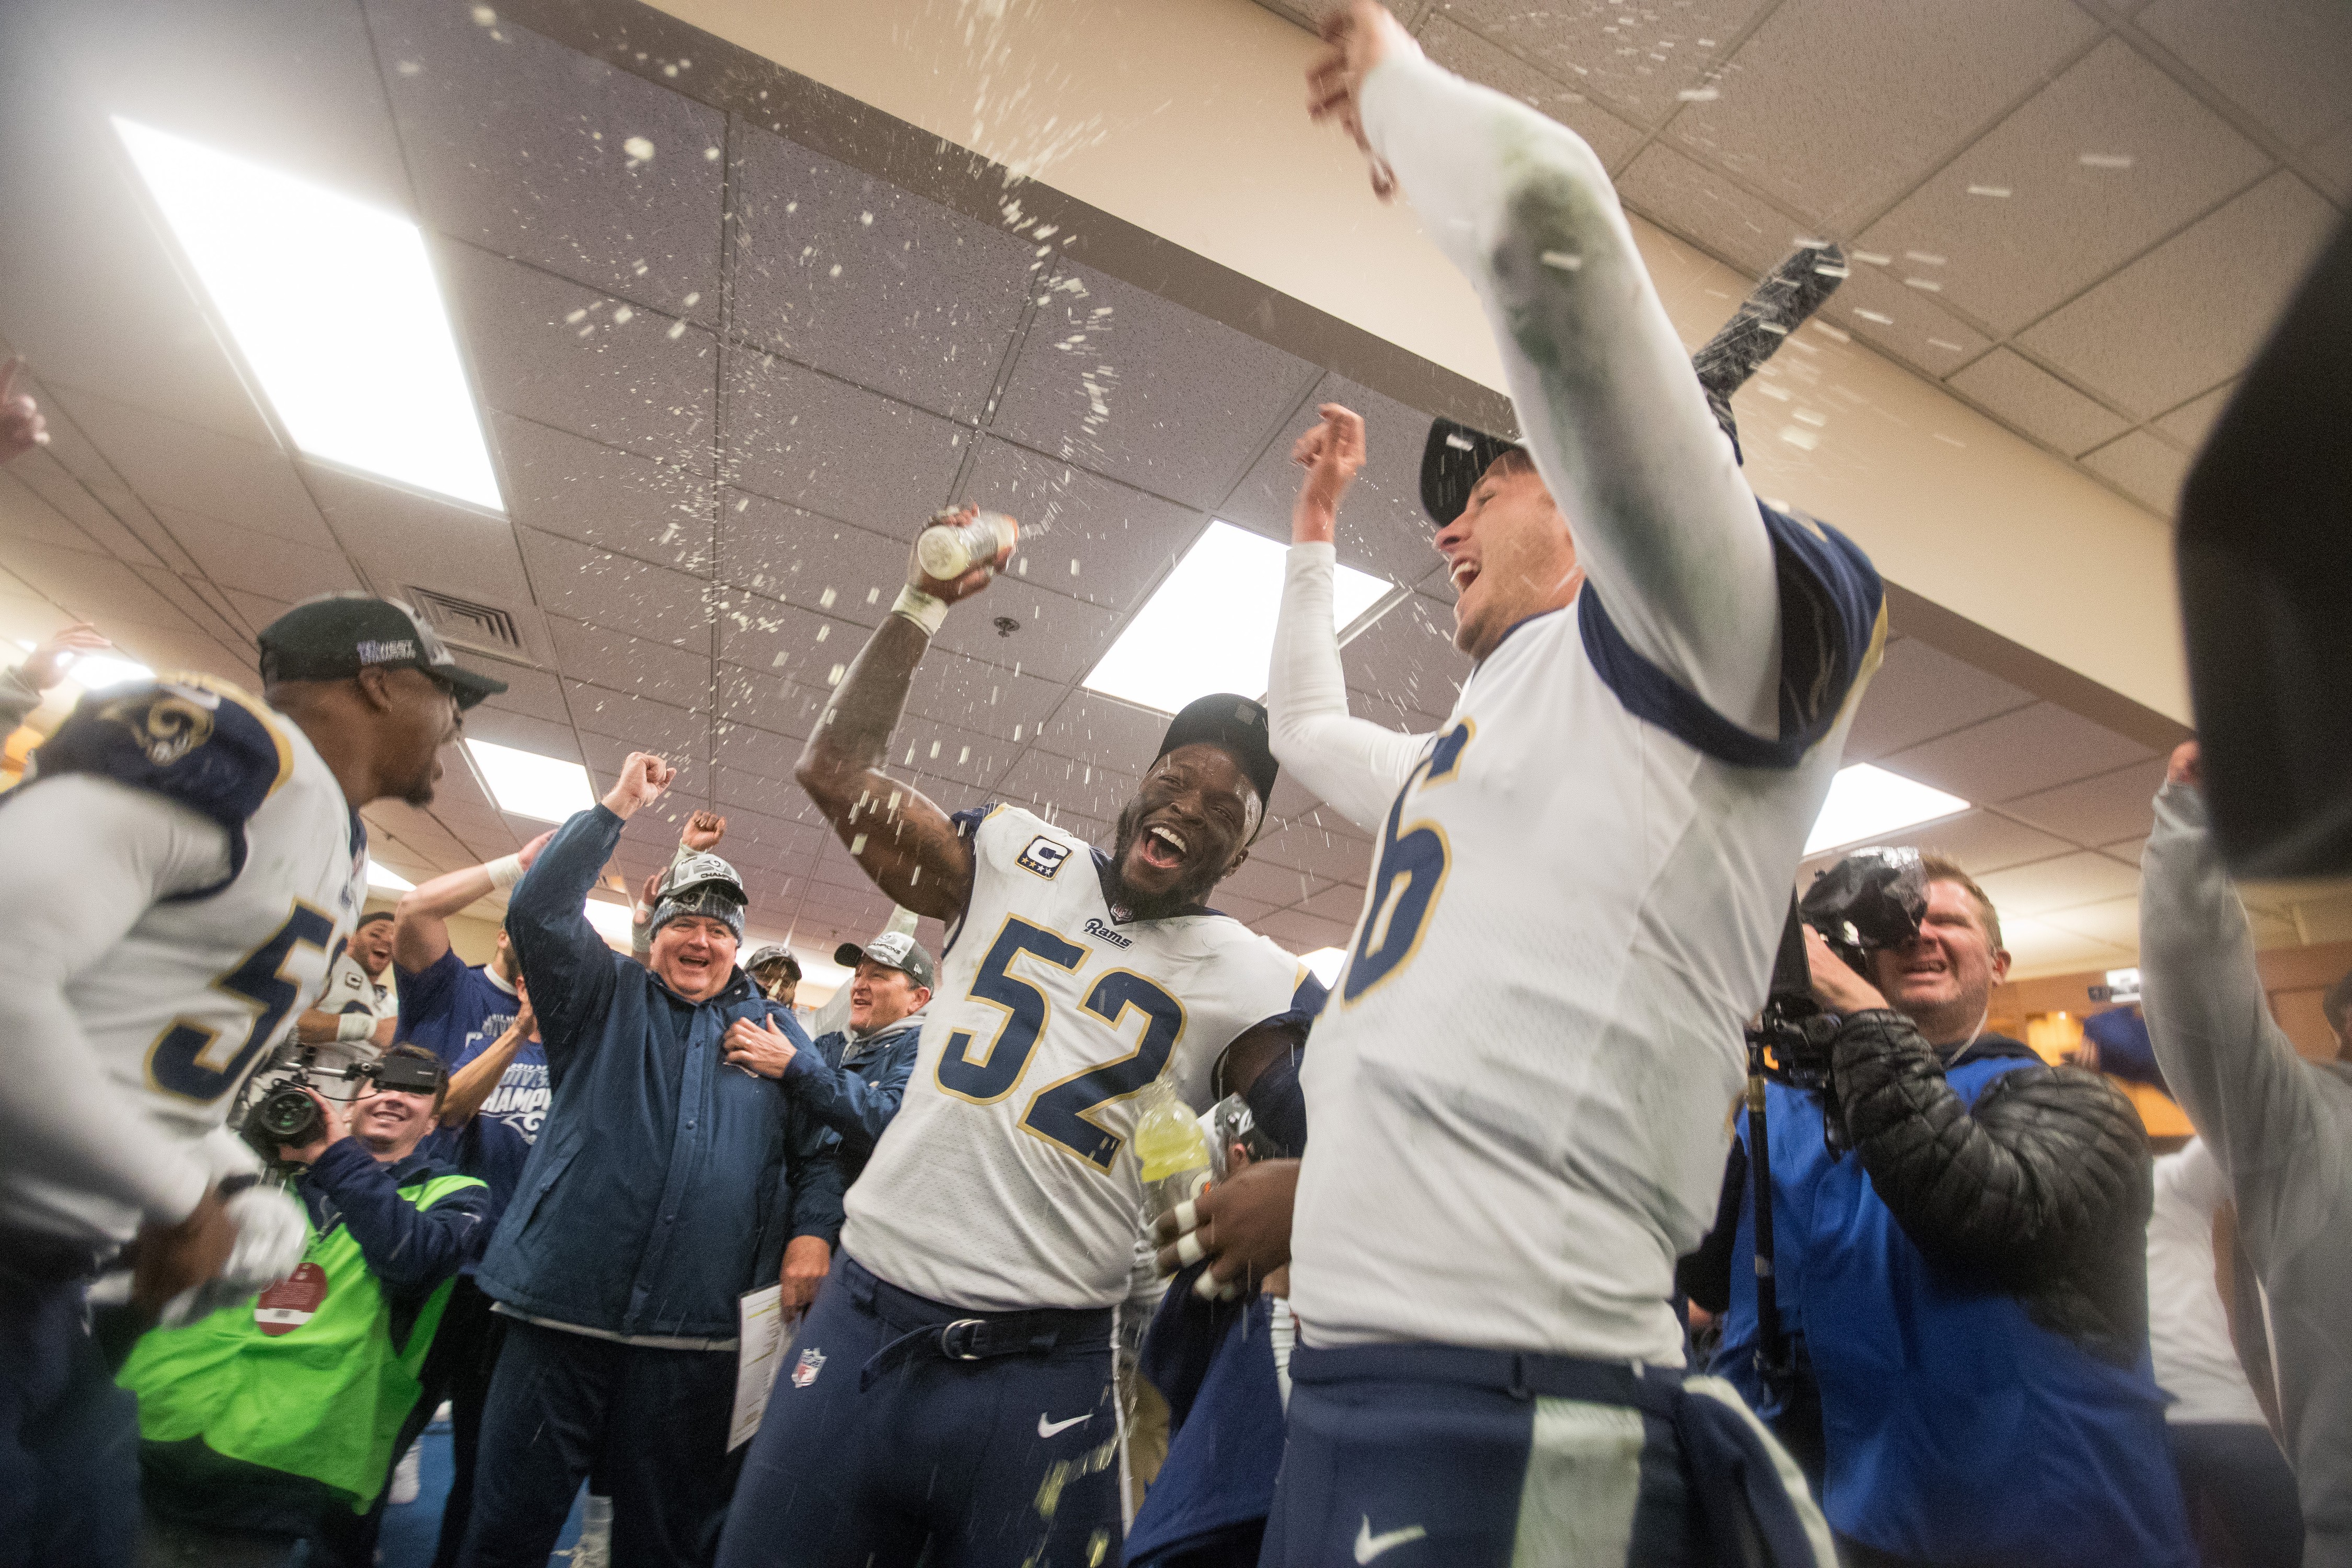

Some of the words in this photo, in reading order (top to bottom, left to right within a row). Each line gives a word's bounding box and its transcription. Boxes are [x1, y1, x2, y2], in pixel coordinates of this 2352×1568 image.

[1027, 839, 1068, 868] C
[1083, 918, 1133, 948] Rams
[143, 896, 348, 1107] 5
[933, 912, 1187, 1175] 52
[479, 1087, 551, 1113] HAMPI
